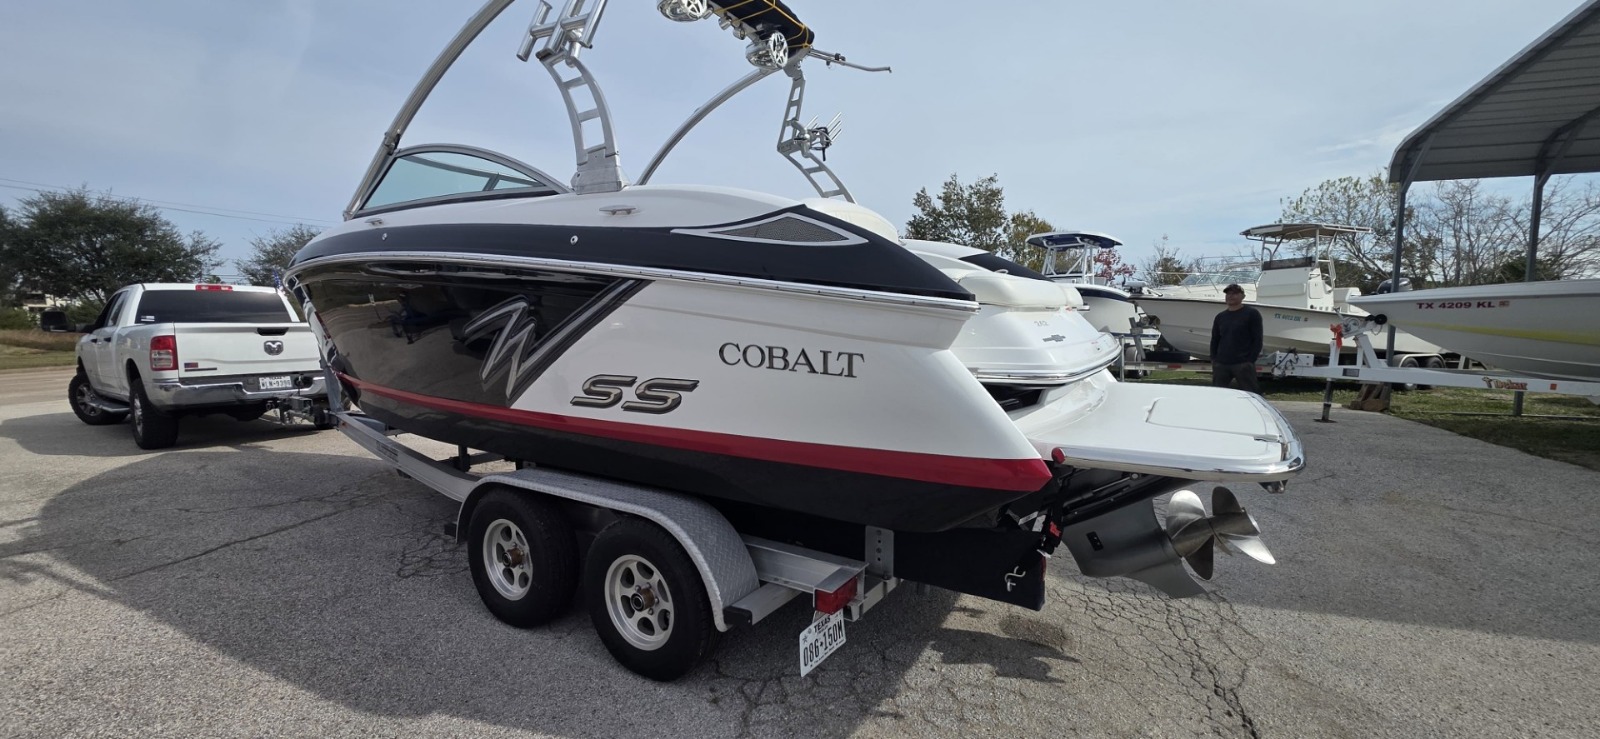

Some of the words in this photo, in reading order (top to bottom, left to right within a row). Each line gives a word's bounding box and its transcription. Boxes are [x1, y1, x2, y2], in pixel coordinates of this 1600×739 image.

[1438, 301, 1472, 309] 4209
[1476, 301, 1495, 309] KL
[718, 342, 865, 378] COBALT
[570, 374, 699, 415] SS
[814, 615, 831, 633] TEXAS
